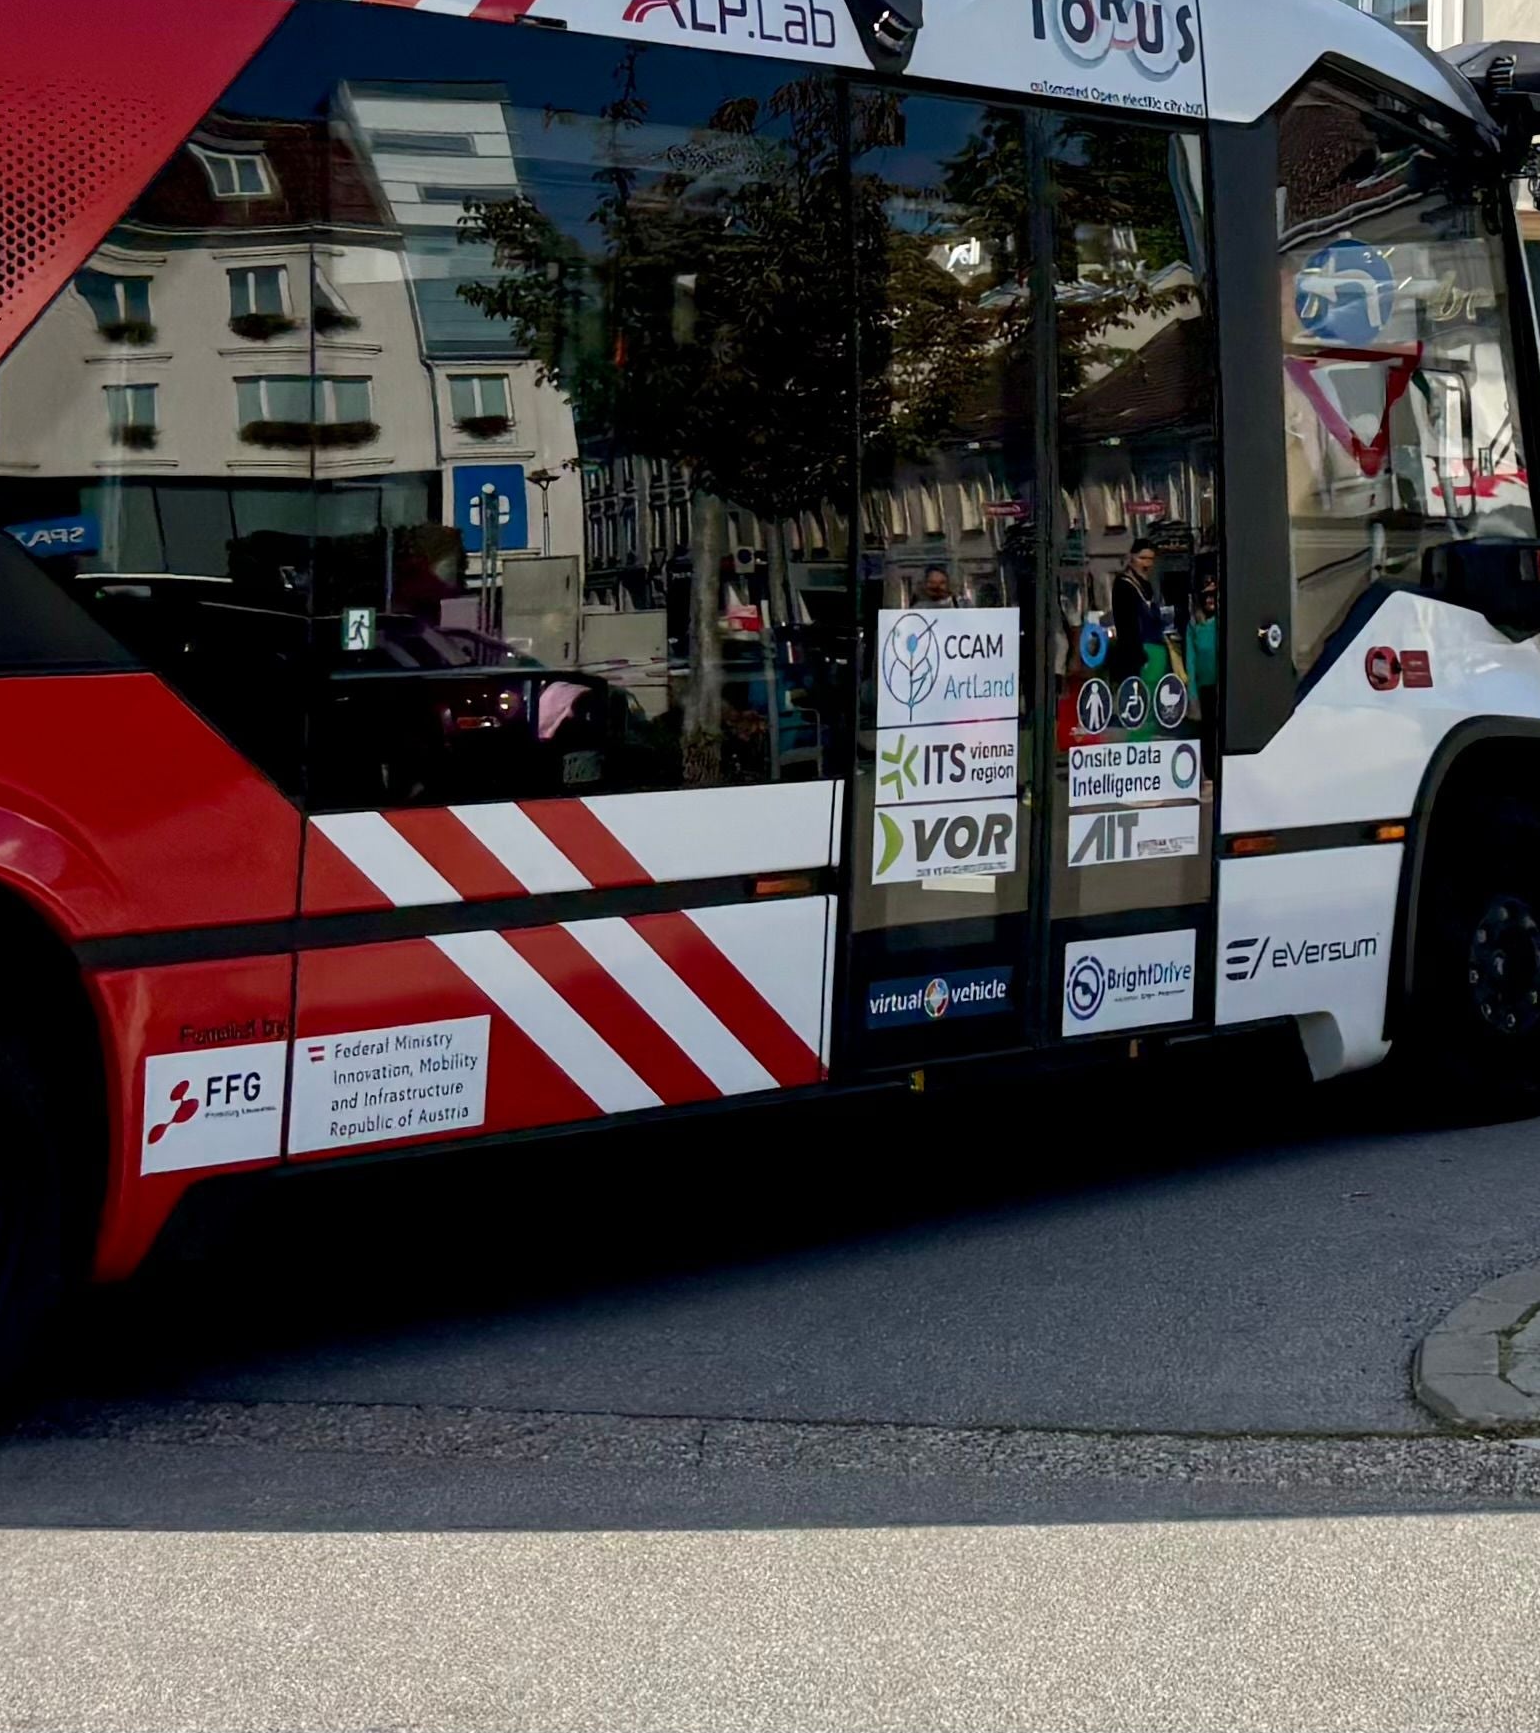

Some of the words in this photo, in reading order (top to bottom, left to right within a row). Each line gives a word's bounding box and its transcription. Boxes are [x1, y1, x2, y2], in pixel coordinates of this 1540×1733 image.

[944, 634, 1004, 660] CCAM
[943, 672, 1015, 700] ArtLand
[923, 743, 967, 786] ITS
[970, 741, 1014, 759] vienna
[1071, 747, 1122, 771] Onsite
[1126, 745, 1162, 766] Data
[970, 763, 1014, 784] region
[1072, 773, 1162, 798] Intelligence
[911, 813, 1013, 863] VOR
[1070, 812, 1140, 864] AIT
[1272, 937, 1377, 968] eVersum
[1107, 961, 1192, 993] BrightDrive
[869, 989, 923, 1014] virtual
[951, 979, 1007, 1004] vehicle
[334, 1037, 390, 1059] Federal
[395, 1032, 453, 1051] Ministry
[333, 1064, 413, 1085] Innovation,
[419, 1053, 478, 1074] Mobility
[205, 1071, 262, 1107] FFG
[331, 1092, 359, 1112] and
[364, 1082, 464, 1107] Infrastructure
[330, 1113, 392, 1138] Republic
[398, 1108, 413, 1128] of
[417, 1104, 469, 1124] Austria
